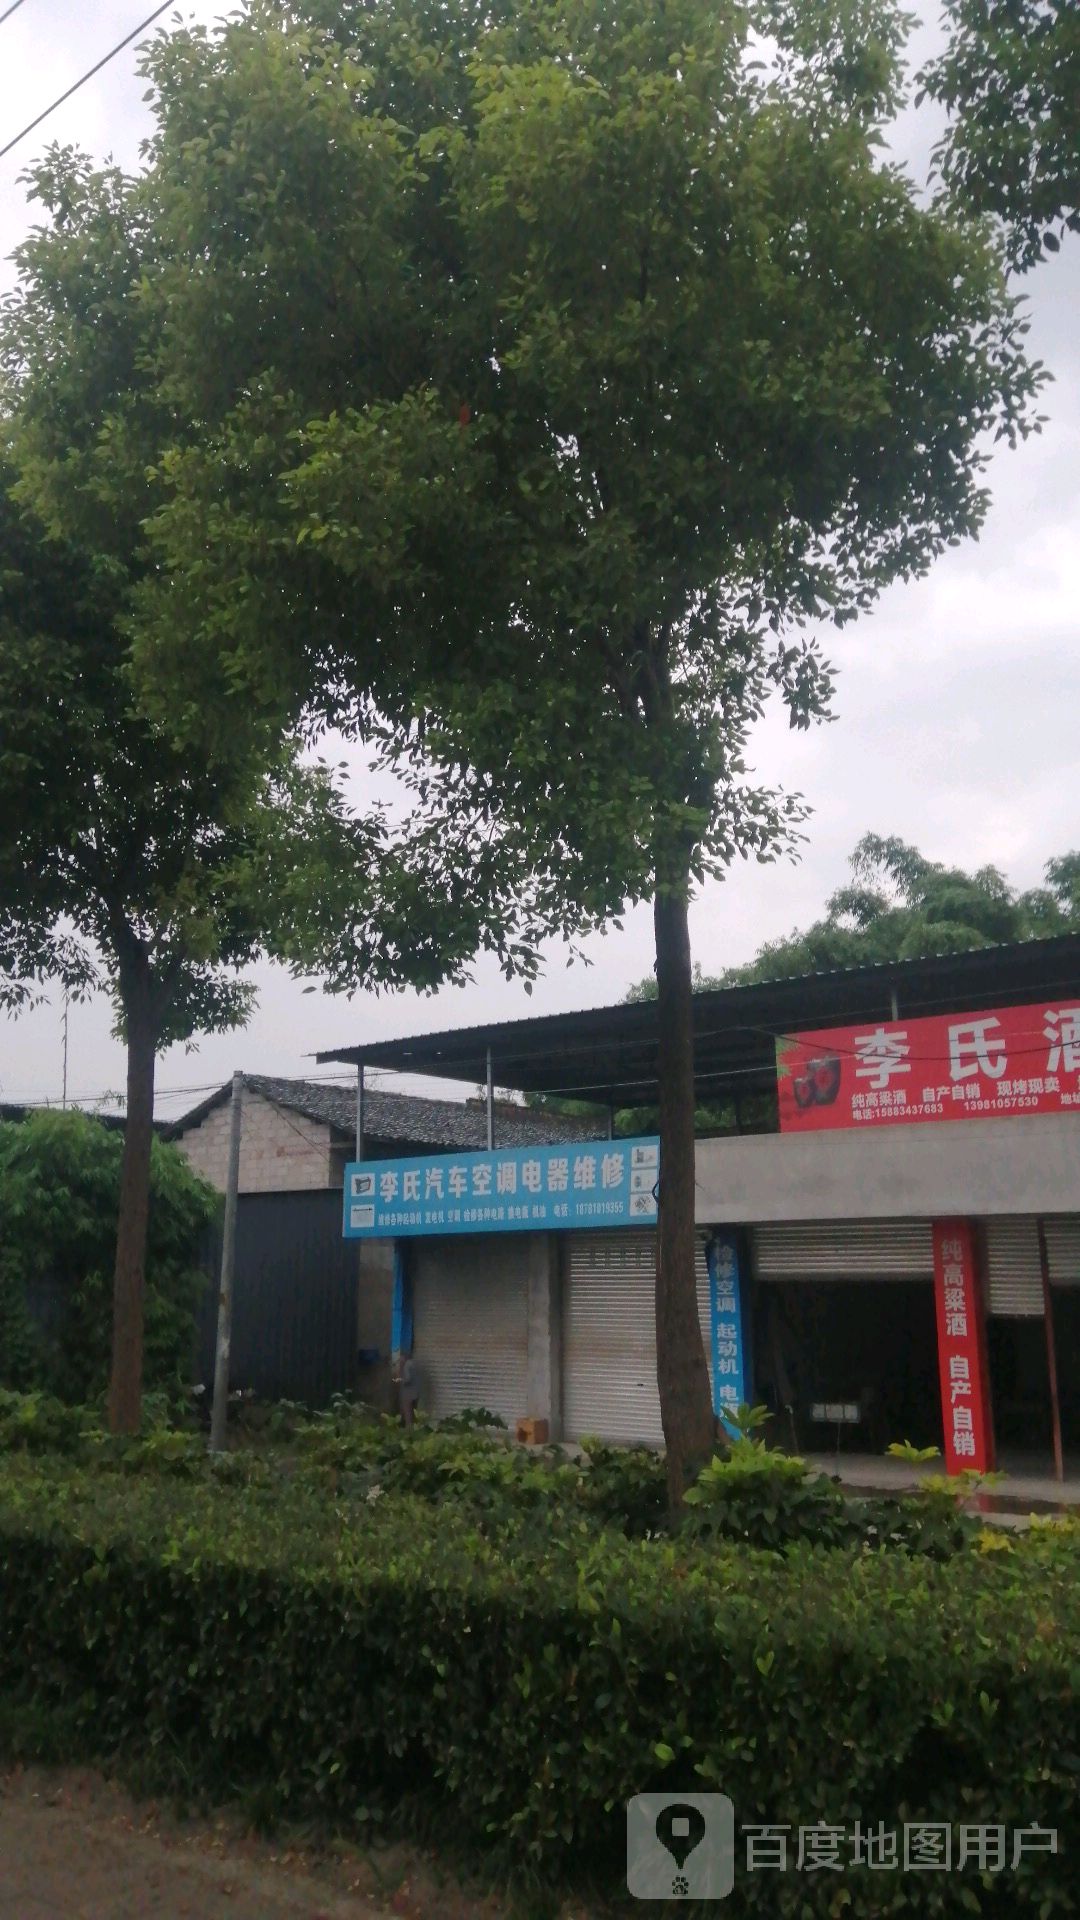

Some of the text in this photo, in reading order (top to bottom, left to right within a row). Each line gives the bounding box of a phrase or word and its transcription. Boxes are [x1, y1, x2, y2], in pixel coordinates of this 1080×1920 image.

[922, 1083, 981, 1103] 自产自销
[997, 1077, 1060, 1097] 现烤现卖
[379, 1152, 625, 1203] 李氏汽车空调电器维修
[716, 1322, 740, 1376] 起动机
[949, 1355, 976, 1457] 自产自销
